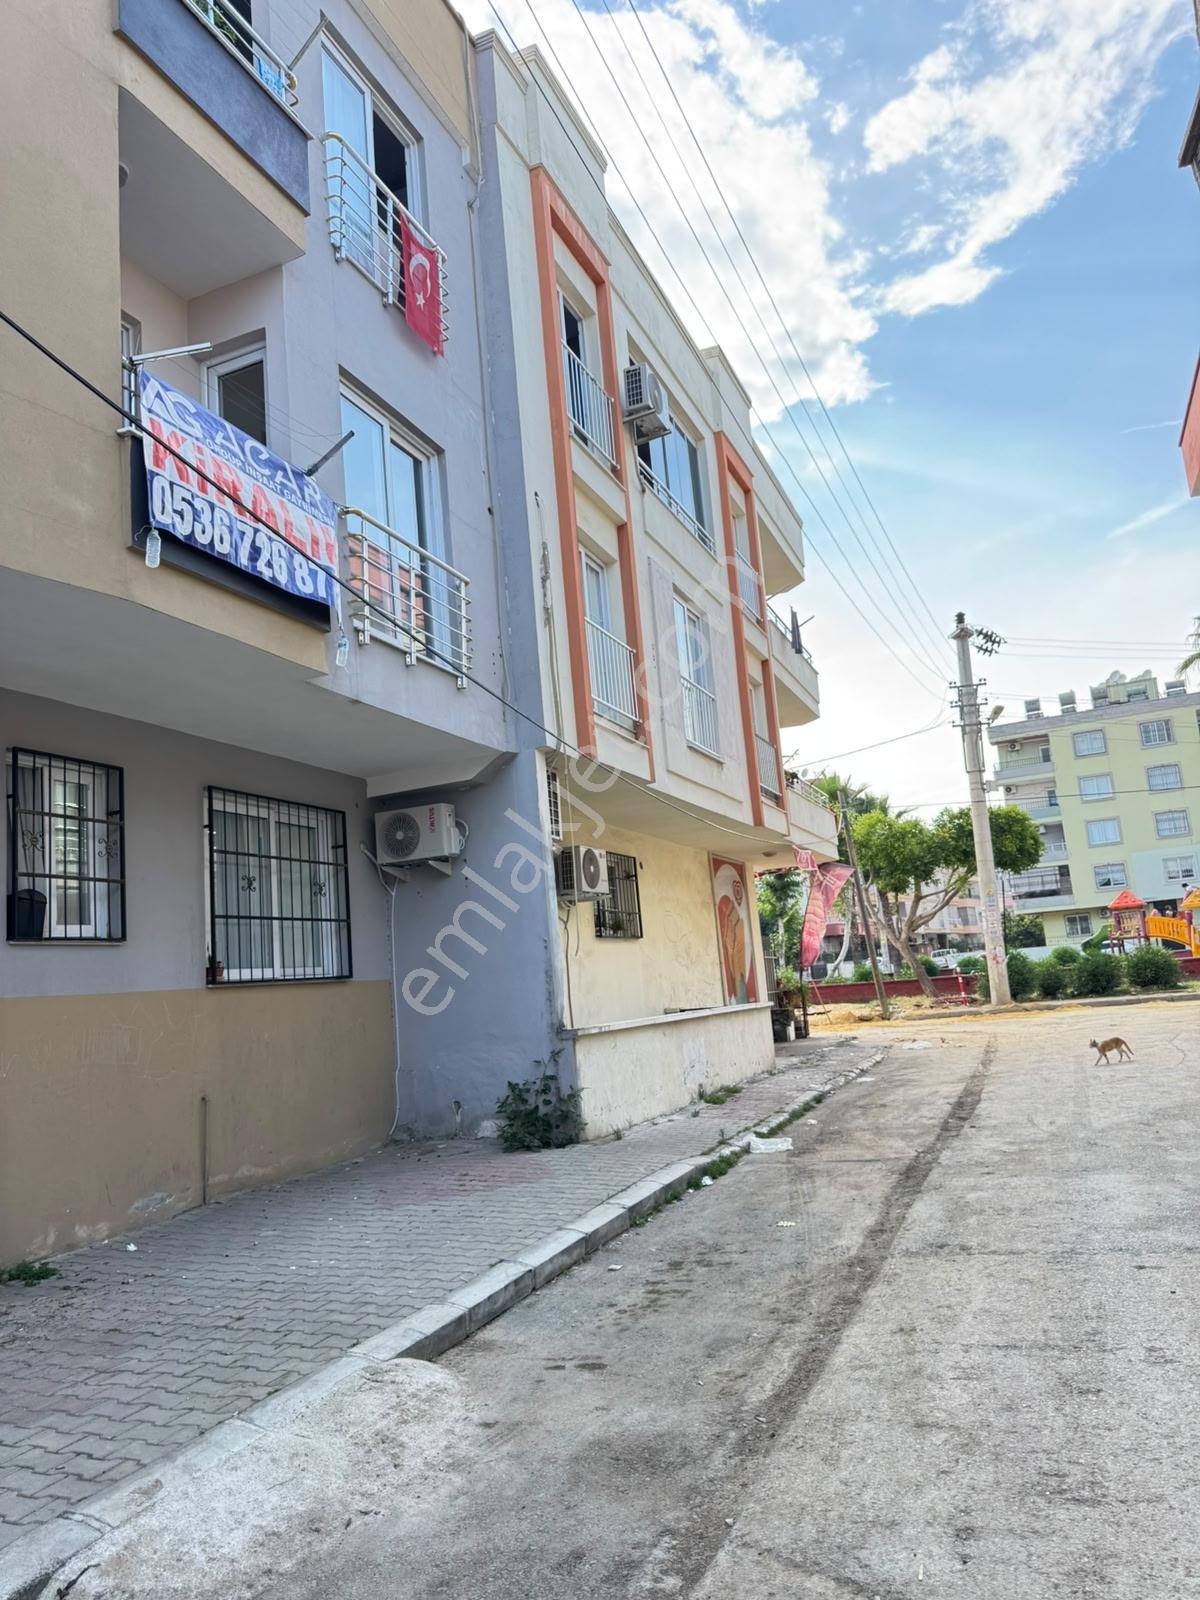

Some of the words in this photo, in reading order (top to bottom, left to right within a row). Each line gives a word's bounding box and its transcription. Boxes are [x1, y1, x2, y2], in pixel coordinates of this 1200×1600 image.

[215, 420, 327, 515] ACAR
[152, 475, 231, 555] 0536
[237, 520, 288, 585] 726
